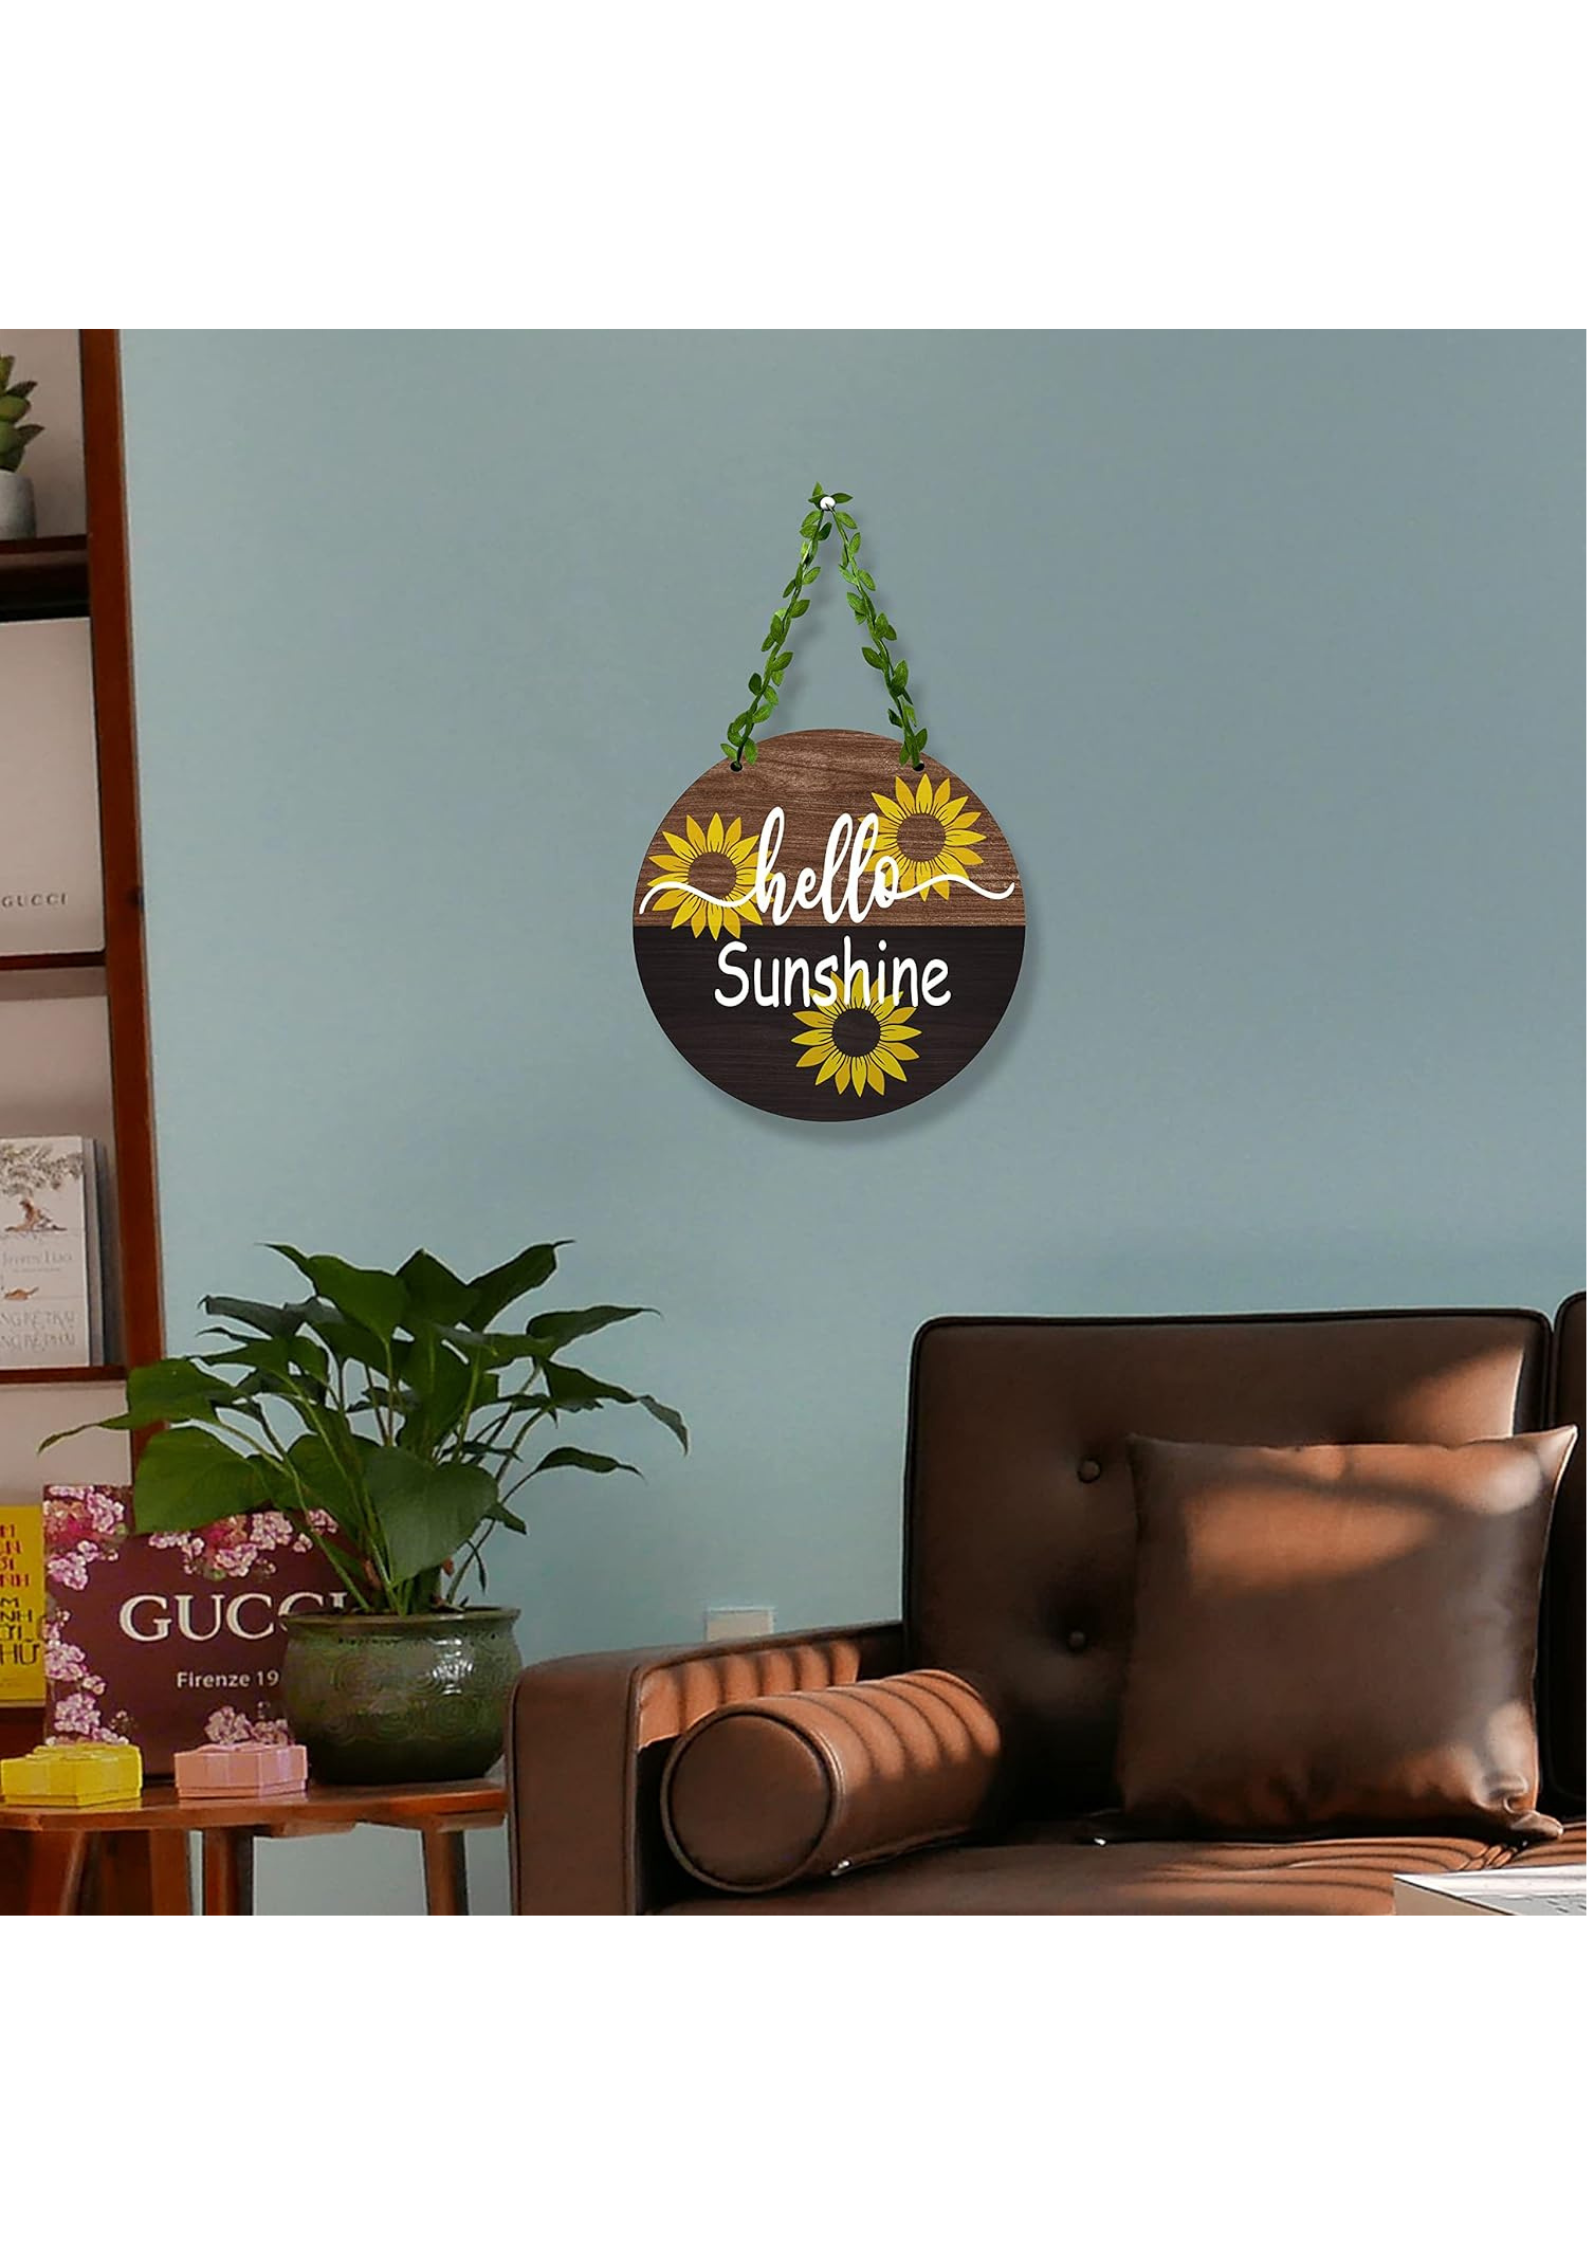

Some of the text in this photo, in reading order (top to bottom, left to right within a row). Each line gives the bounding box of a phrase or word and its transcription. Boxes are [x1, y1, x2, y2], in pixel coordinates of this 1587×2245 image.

[1, 892, 66, 908] GUCCI
[714, 935, 953, 1008] Sunshine
[176, 1671, 251, 1688] Firenze
